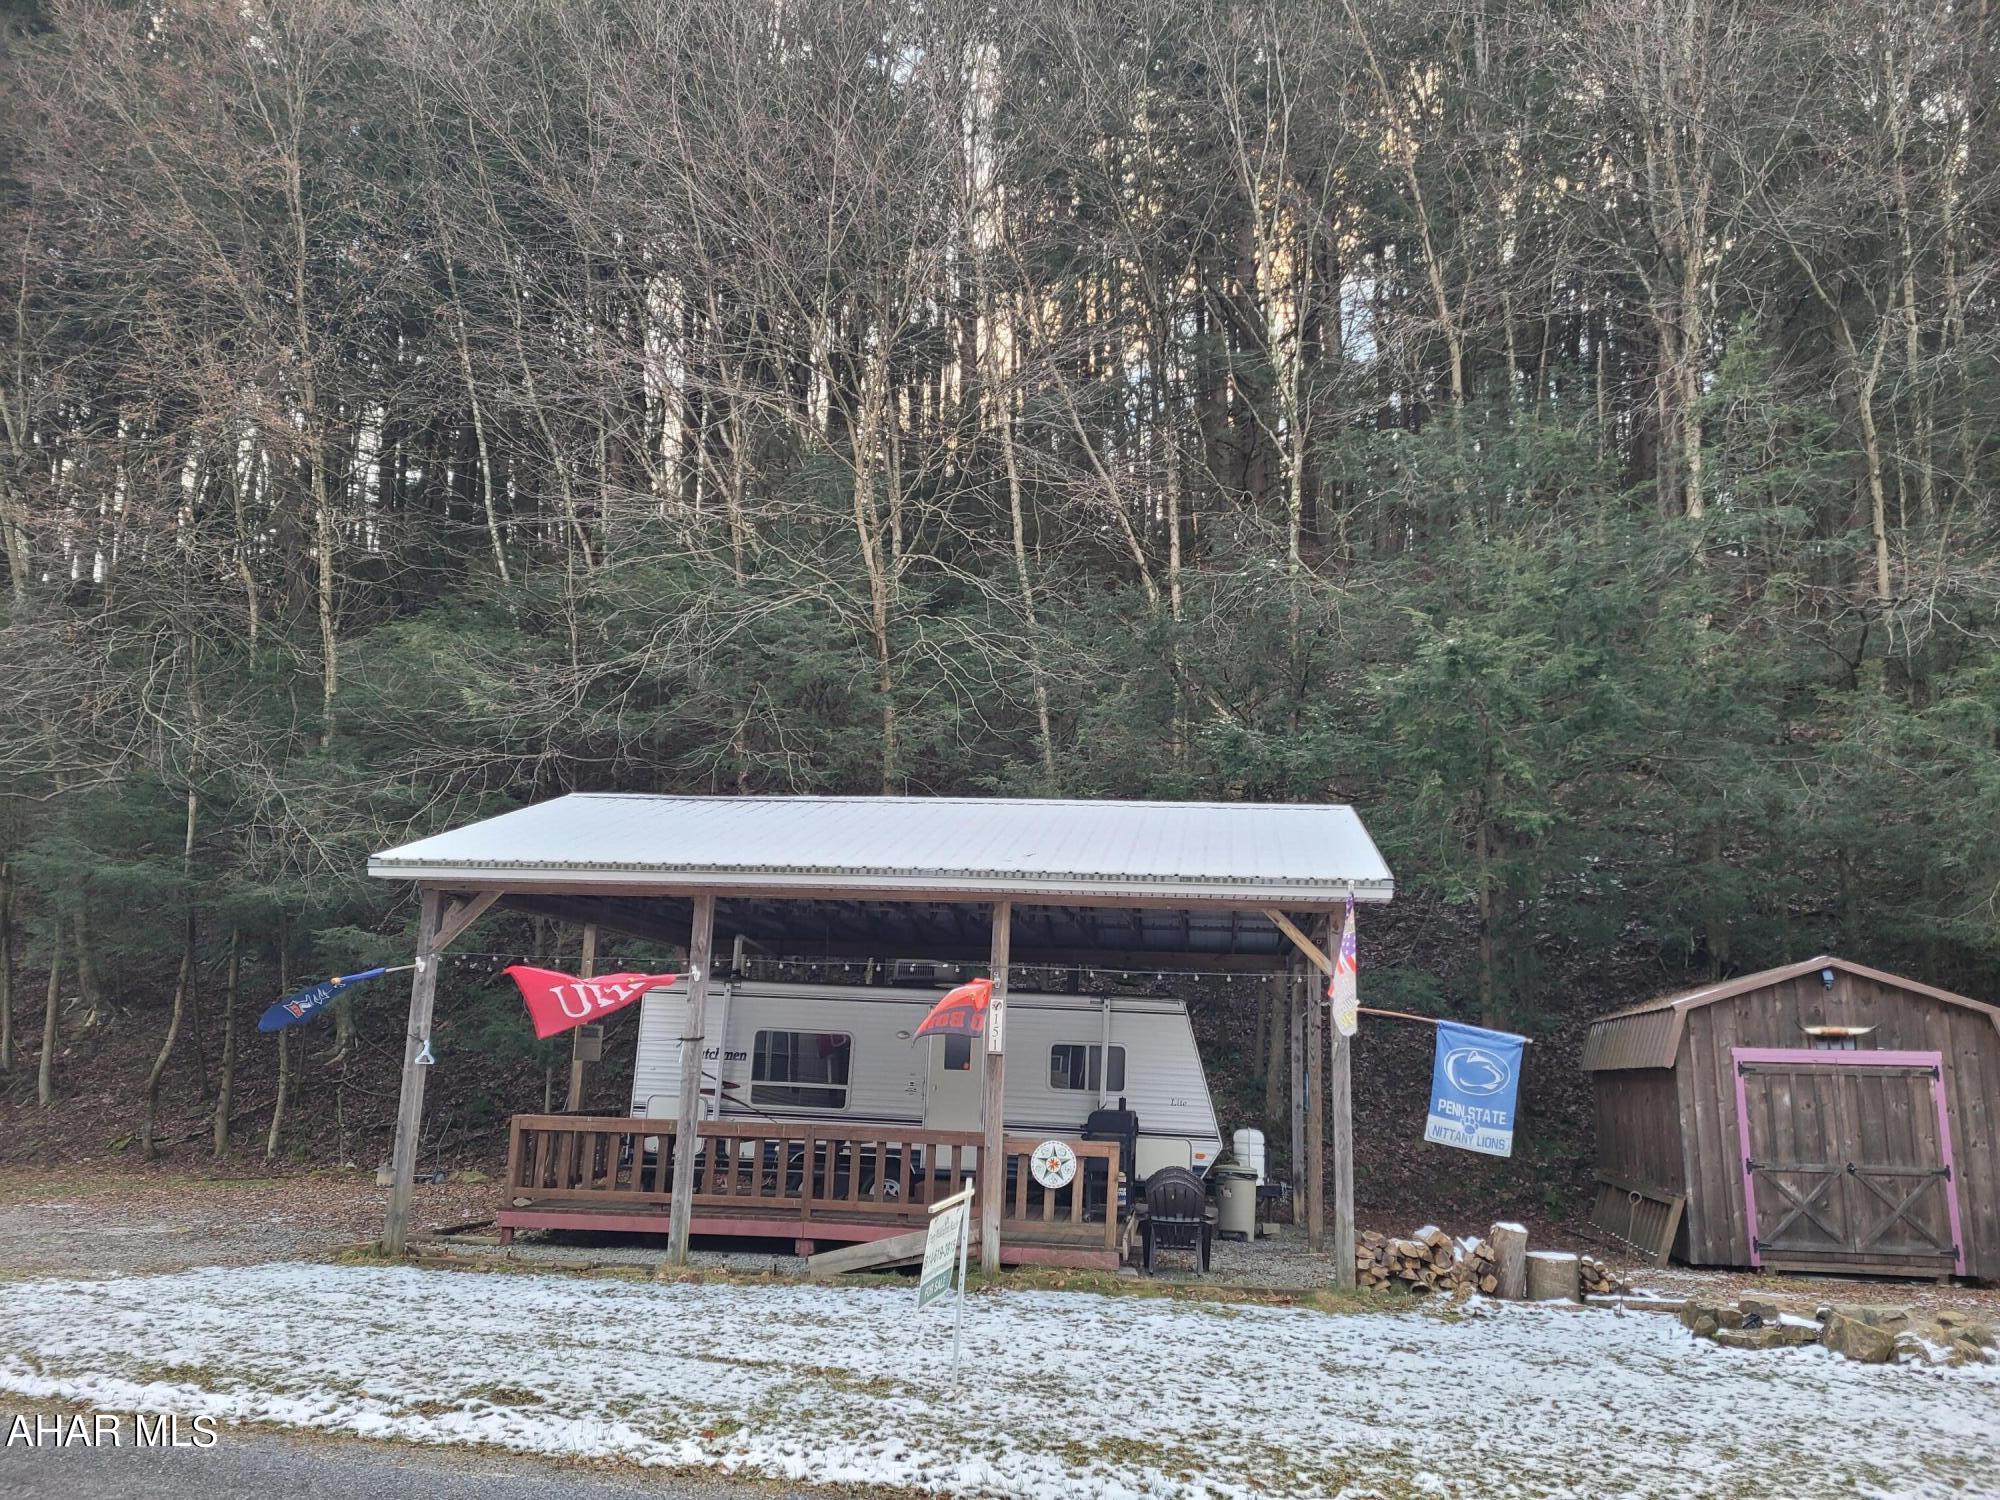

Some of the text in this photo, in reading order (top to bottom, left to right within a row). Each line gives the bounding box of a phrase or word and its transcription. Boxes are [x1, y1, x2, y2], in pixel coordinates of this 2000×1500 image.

[991, 1013, 999, 1051] 151
[1170, 1097, 1188, 1107] Lite
[1437, 1098, 1507, 1125] PENN STATE
[1432, 1124, 1506, 1151] NITTANY LIONS
[934, 1276, 947, 1293] SALE
